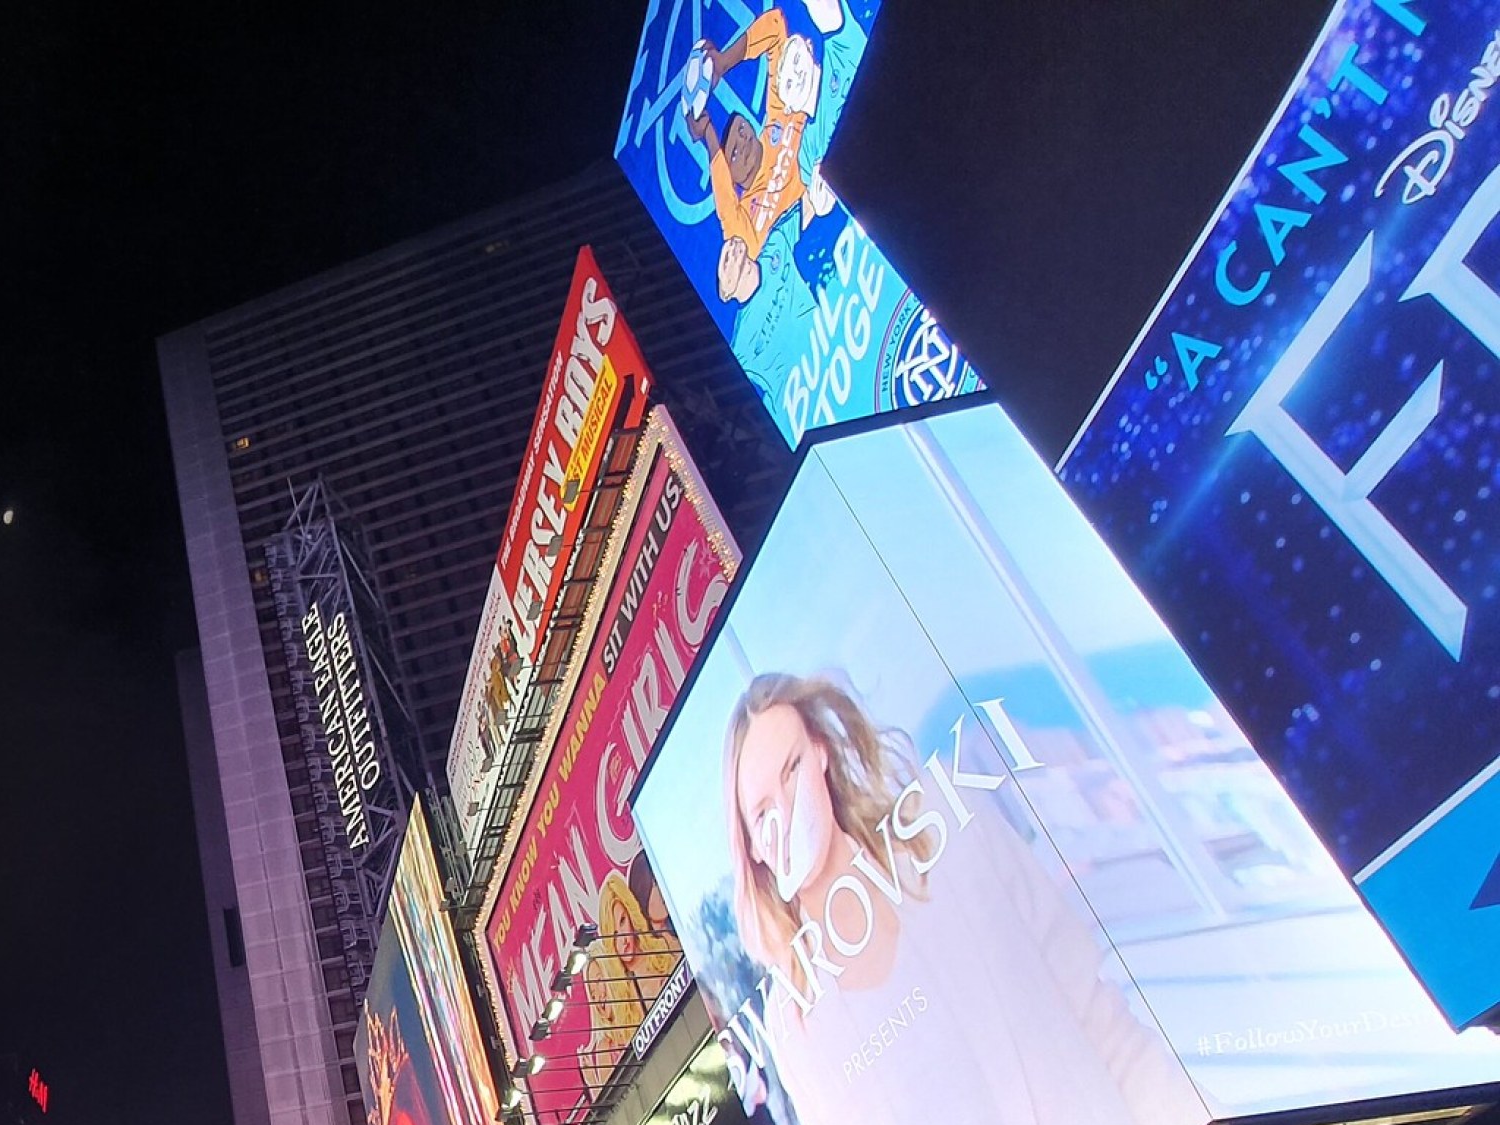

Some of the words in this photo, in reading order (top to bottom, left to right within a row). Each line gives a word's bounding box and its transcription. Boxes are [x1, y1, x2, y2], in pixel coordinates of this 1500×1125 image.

[579, 376, 614, 463] MUSICAL
[784, 225, 856, 448] BUILD
[512, 440, 567, 662] JERSEY
[555, 277, 617, 448] BOYS
[302, 601, 334, 697] EAGLE
[327, 611, 381, 790] OUTFITTERS
[318, 688, 370, 849] AMERICAN
[492, 919, 511, 952] YOU
[509, 836, 539, 914] KNOW
[537, 785, 561, 839] YOU
[558, 672, 607, 782] WANNA
[602, 621, 624, 675] SIT
[620, 542, 663, 625] WITH
[717, 697, 1046, 1092] SWAROVSKI
[634, 967, 686, 1054] OUTFRONT
[842, 986, 929, 1085] PRESENTS
